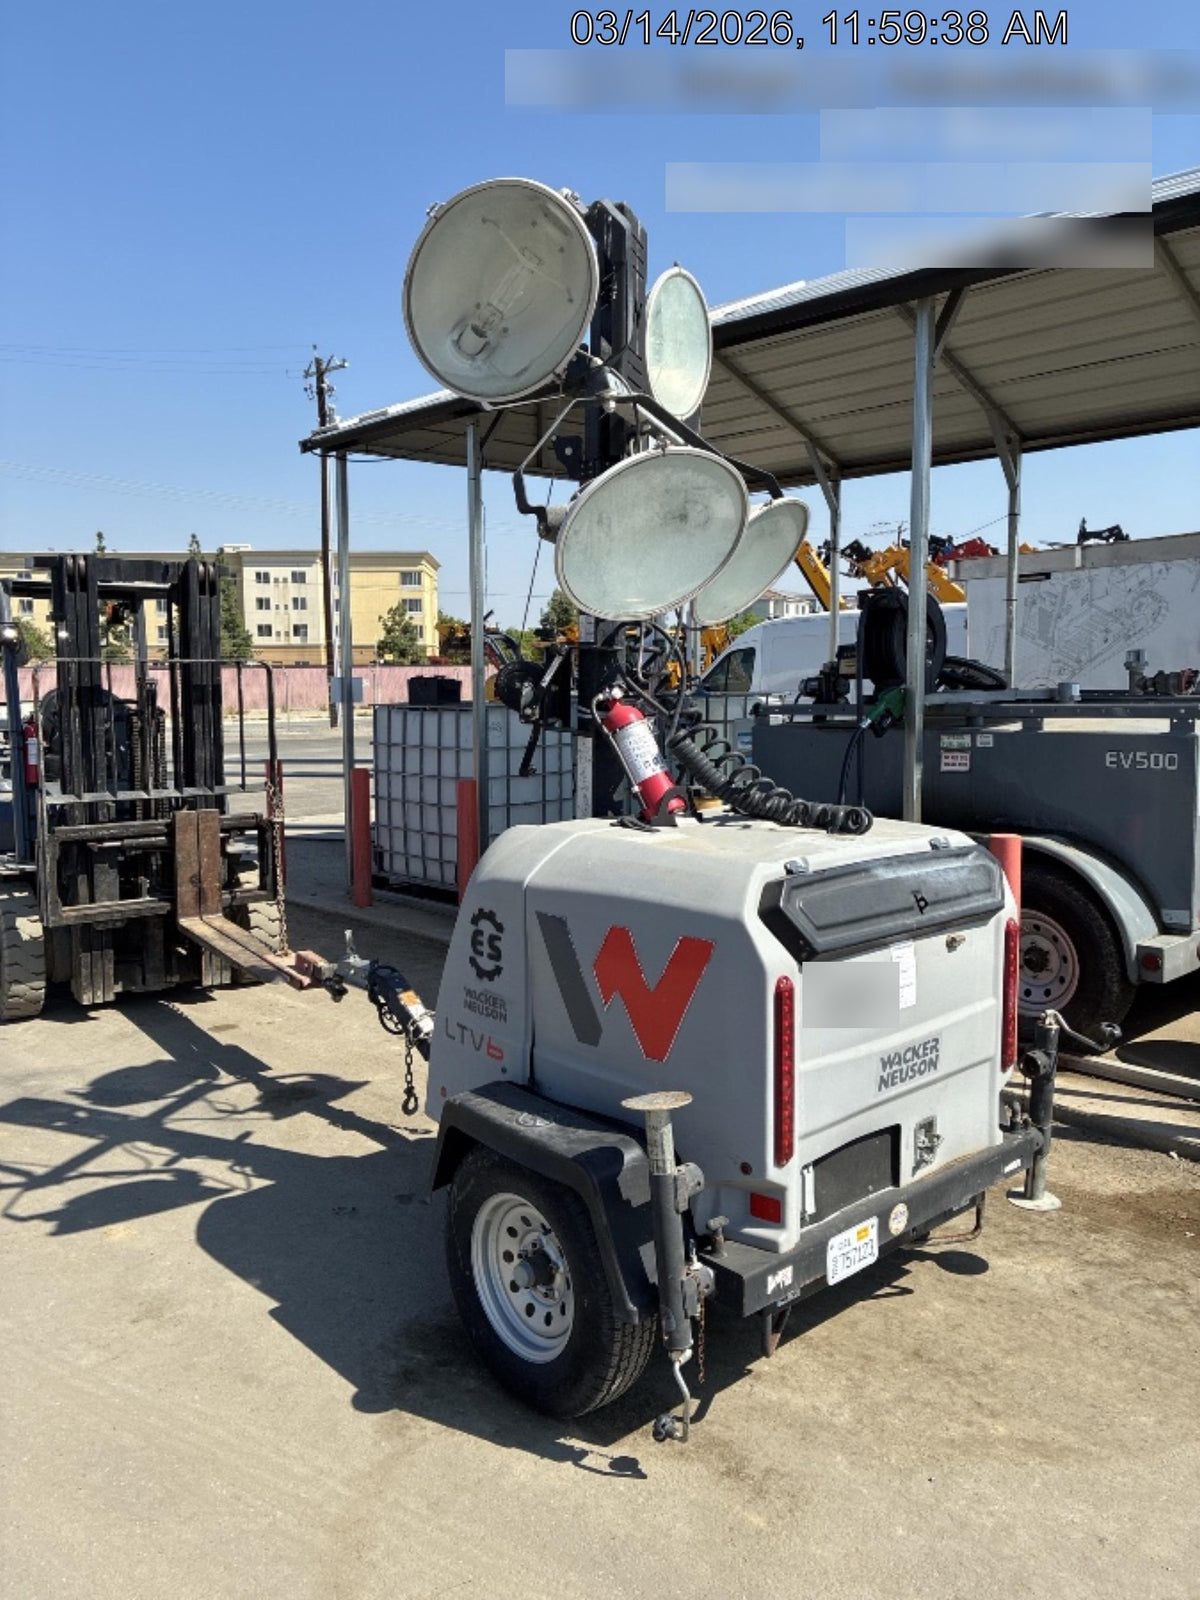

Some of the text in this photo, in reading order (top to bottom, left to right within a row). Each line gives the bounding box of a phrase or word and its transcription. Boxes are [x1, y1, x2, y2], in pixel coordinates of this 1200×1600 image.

[1105, 751, 1179, 770] EV500
[471, 929, 502, 962] ES
[463, 999, 507, 1024] NEUSON
[464, 986, 507, 1012] WACKER
[880, 1037, 939, 1072] WACKER
[878, 1054, 940, 1092] NEUSON
